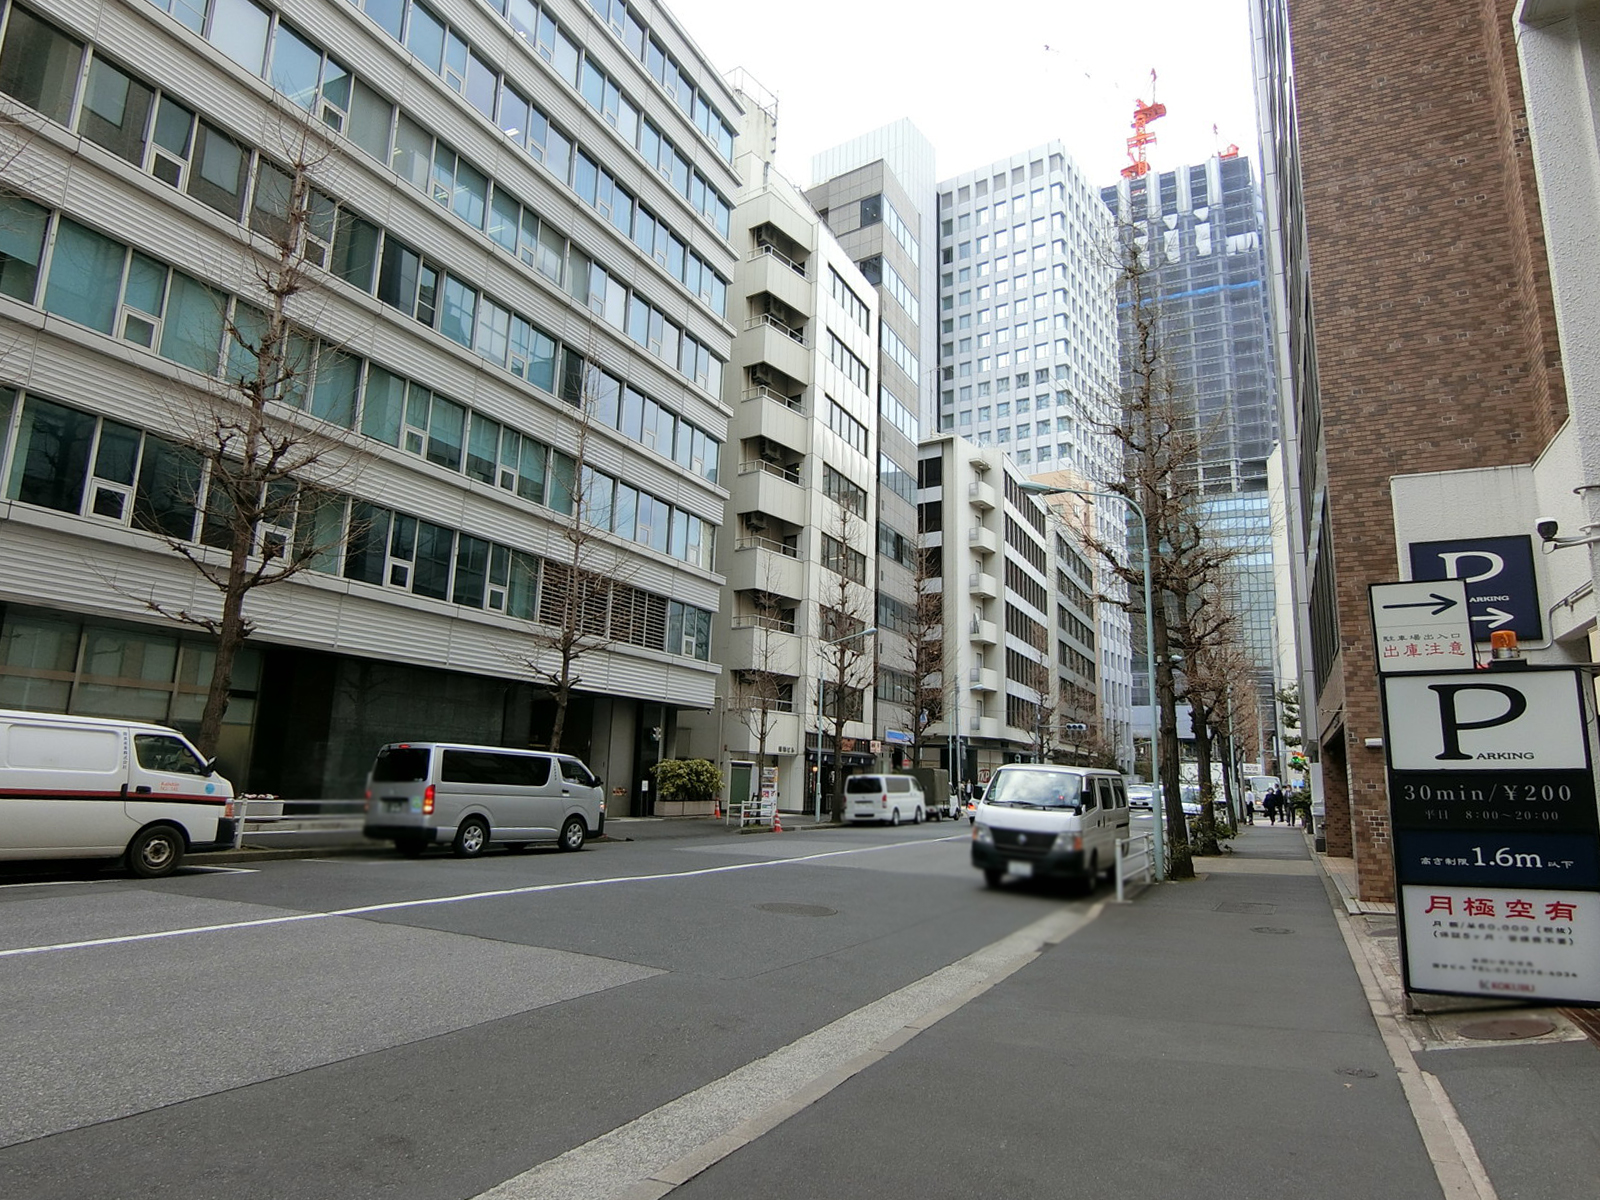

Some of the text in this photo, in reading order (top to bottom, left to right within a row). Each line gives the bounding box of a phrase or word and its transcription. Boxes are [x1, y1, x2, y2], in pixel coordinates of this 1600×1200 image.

[1382, 633, 1461, 642] 駐車場出入口
[1383, 641, 1466, 658] 出庫注意
[1471, 847, 1543, 868] 1.6m
[1425, 895, 1577, 921] 月極空有
